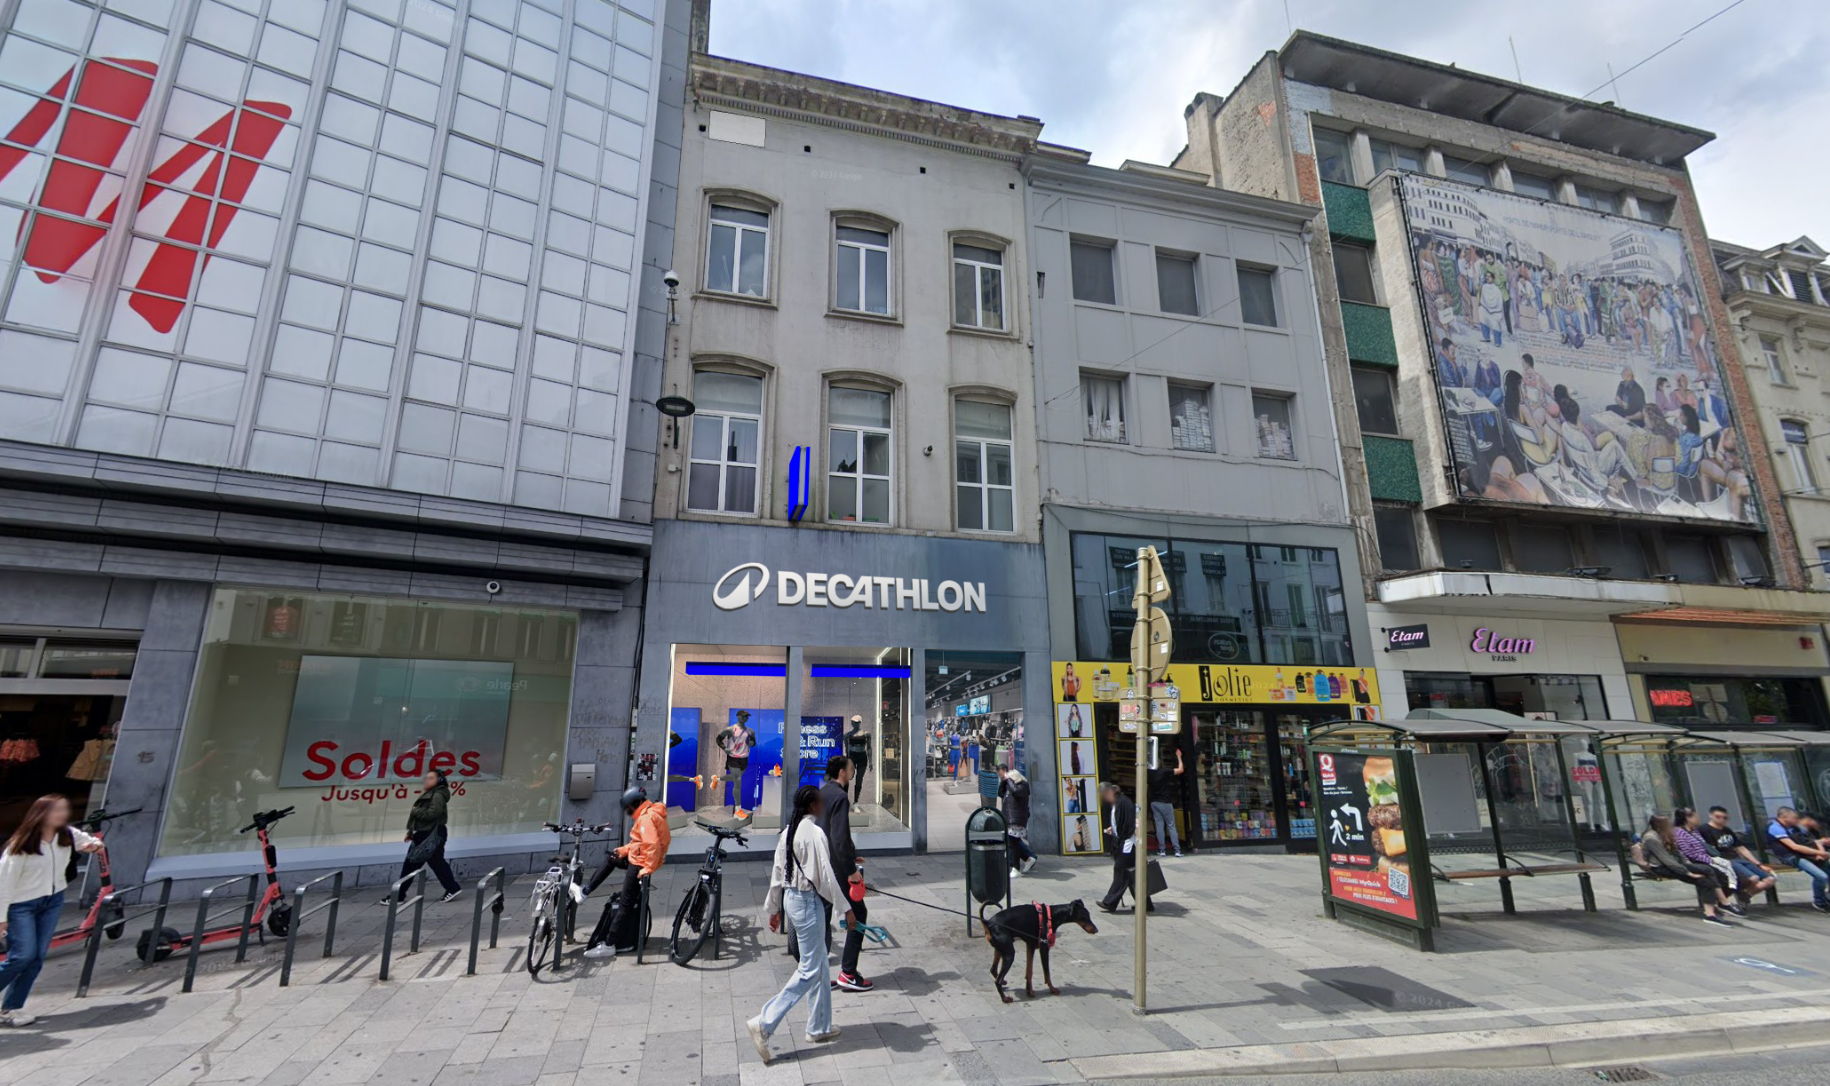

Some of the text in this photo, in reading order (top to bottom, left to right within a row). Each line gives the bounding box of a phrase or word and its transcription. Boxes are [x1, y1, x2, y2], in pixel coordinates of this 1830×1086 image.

[777, 571, 987, 613] DECATHLON
[1390, 629, 1424, 643] Etam
[1471, 627, 1536, 655] Etam
[778, 722, 828, 734] Fness
[807, 735, 836, 748] Run
[302, 739, 481, 781] Soldes
[780, 748, 819, 759] Sore
[321, 784, 408, 804] Jusqu'à
[1351, 833, 1365, 841] min
